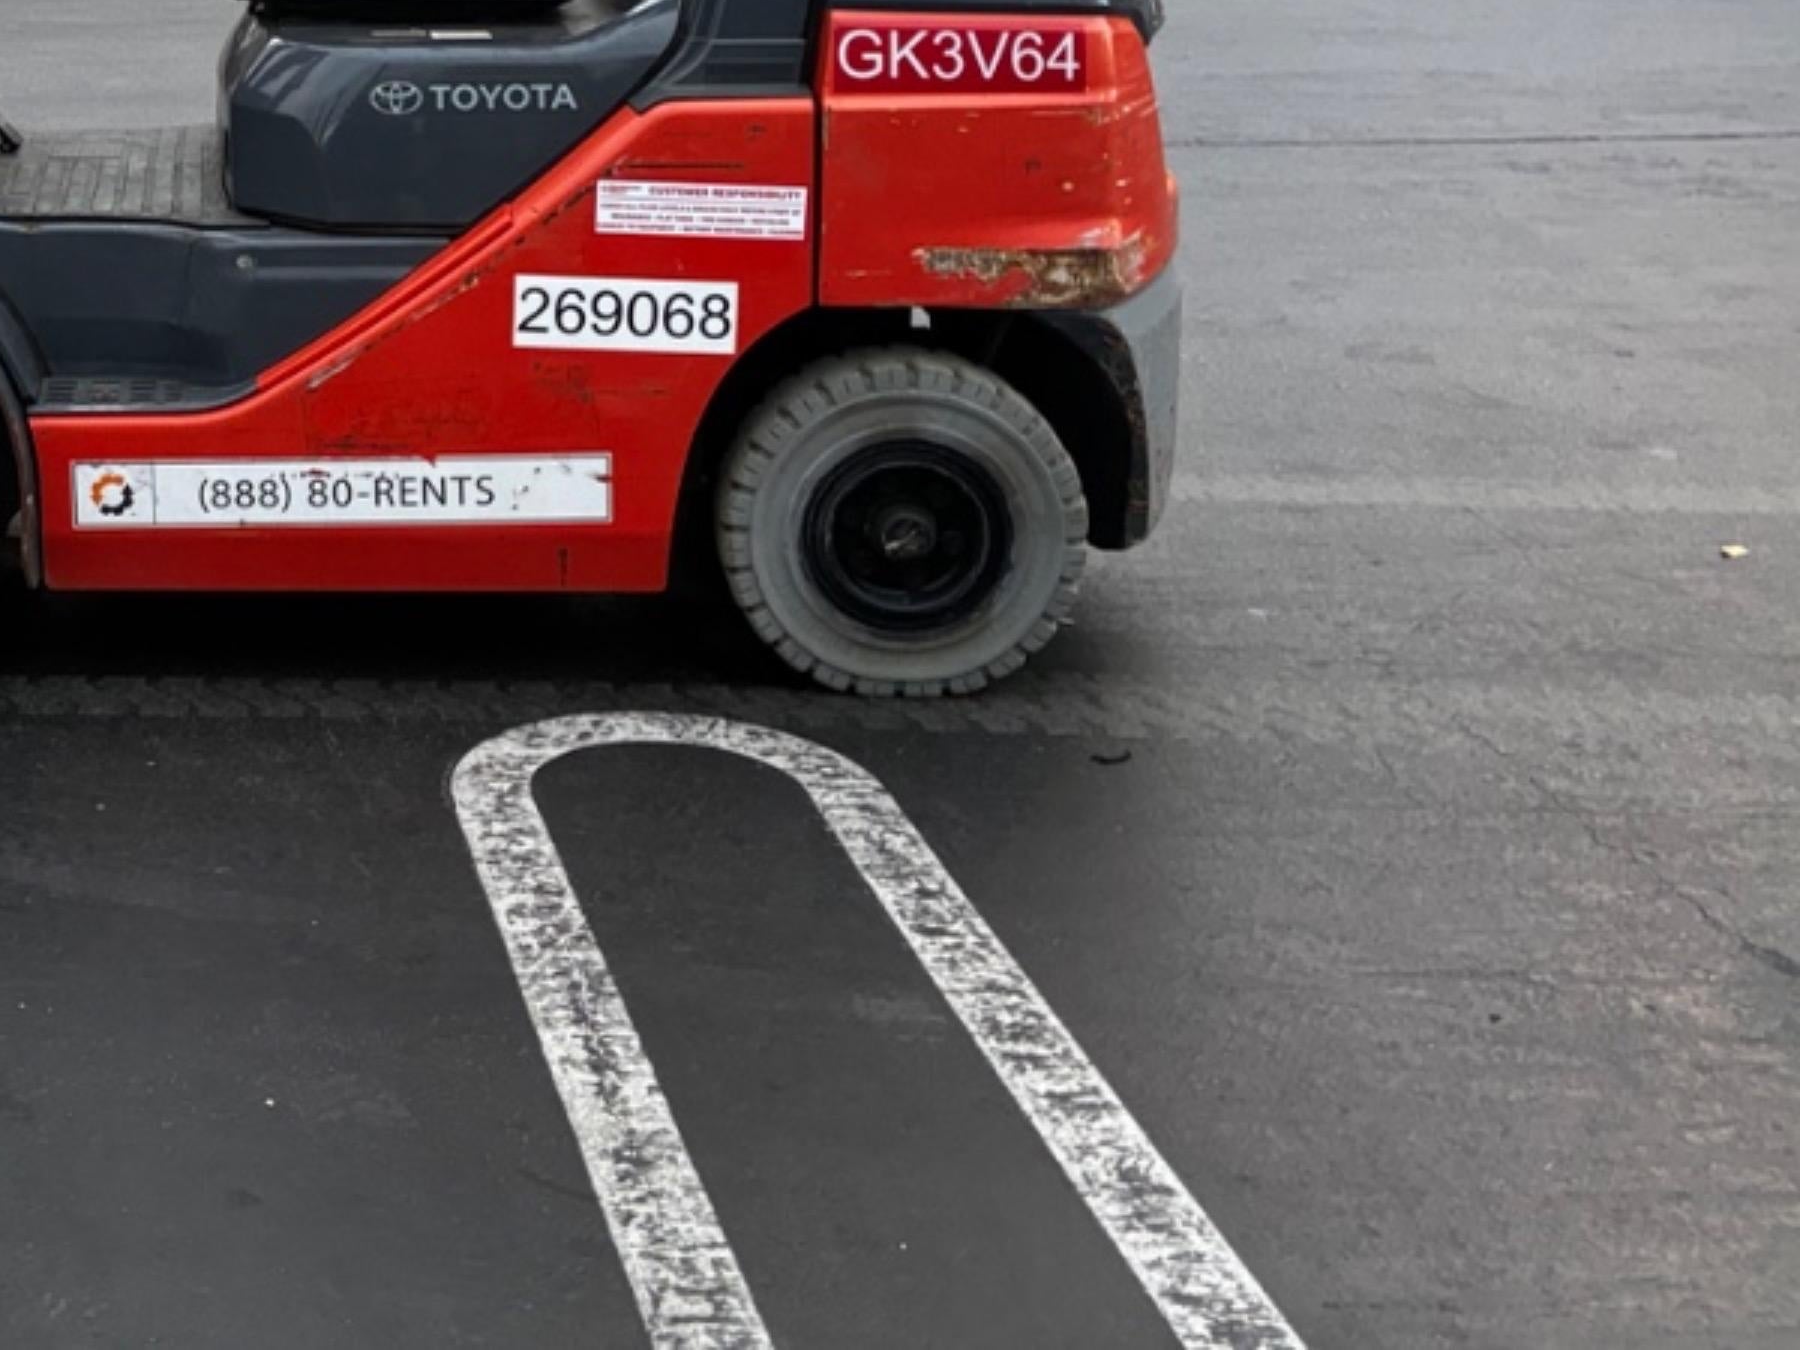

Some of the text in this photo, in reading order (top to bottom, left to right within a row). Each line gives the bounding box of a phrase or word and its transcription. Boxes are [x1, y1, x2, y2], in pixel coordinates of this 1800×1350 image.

[837, 29, 1080, 81] GK3V64
[428, 83, 578, 111] TOYOTA
[518, 286, 731, 339] 269068
[198, 472, 496, 513] (888) 80-RENTS
